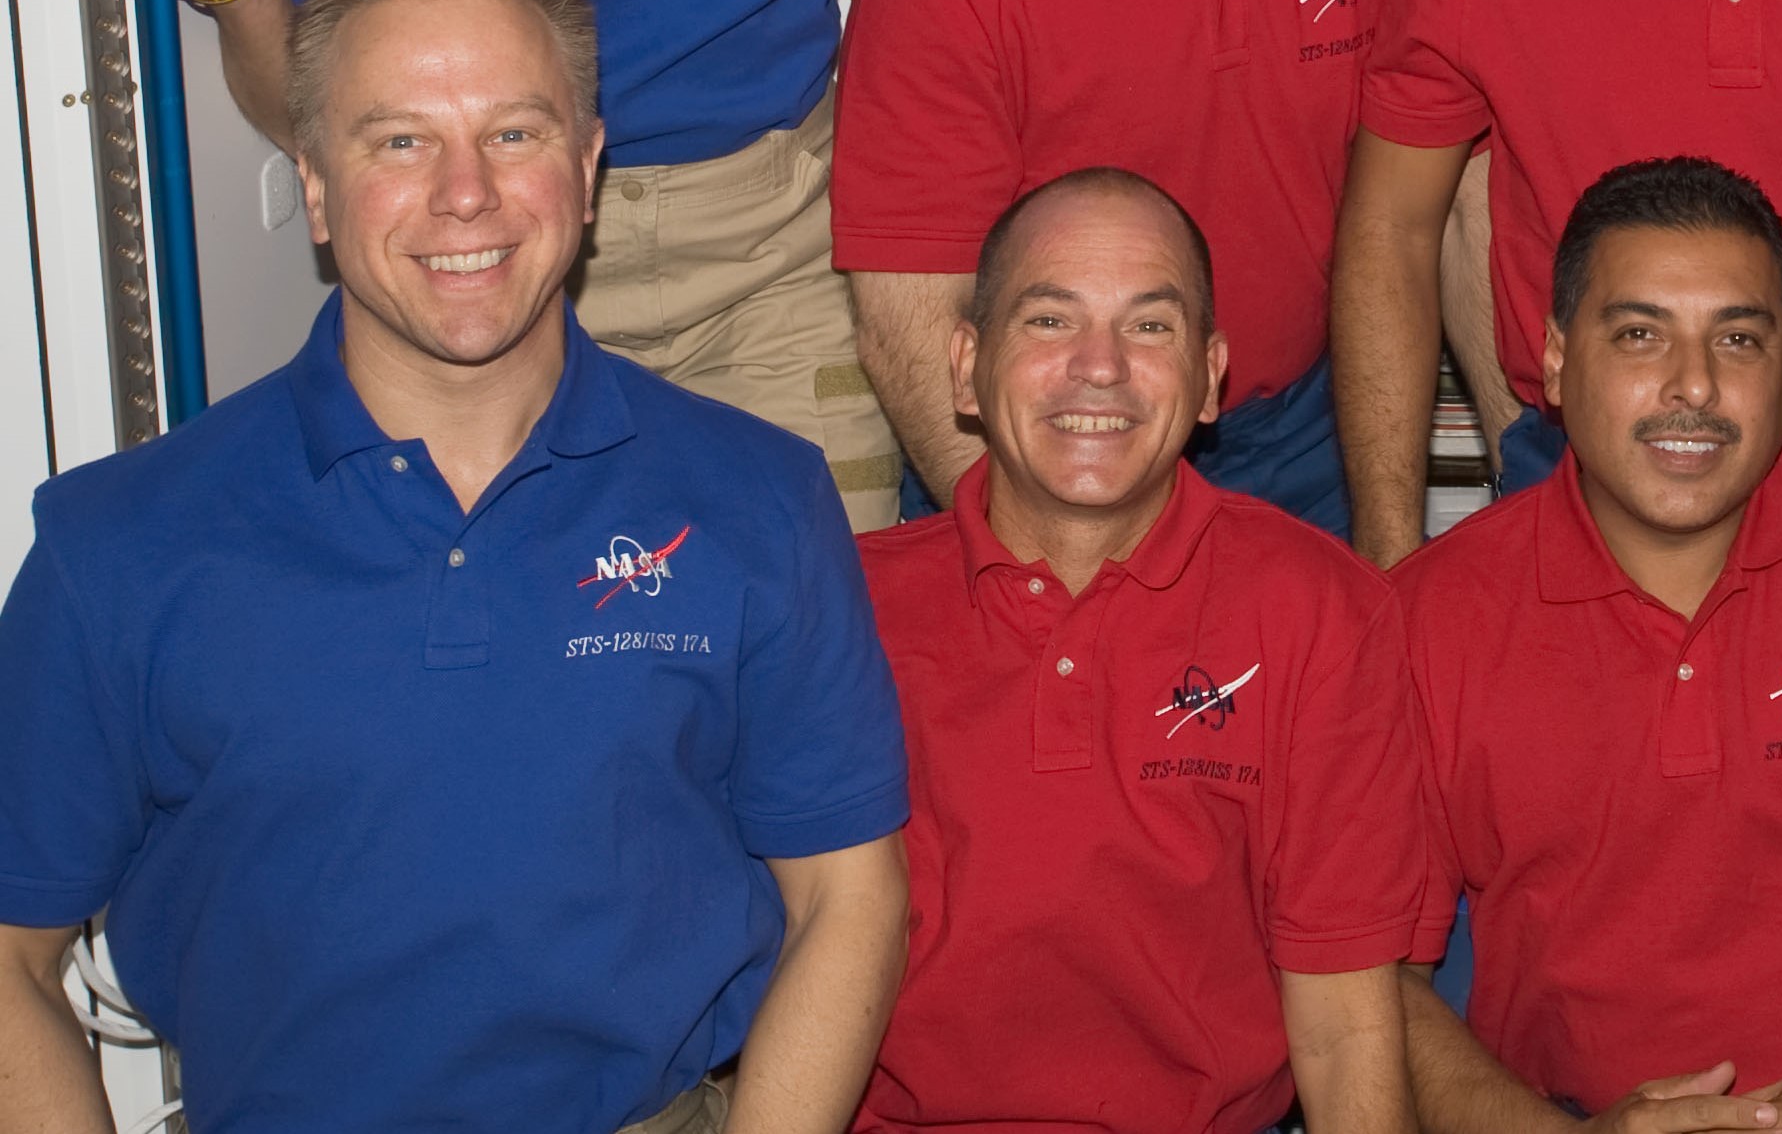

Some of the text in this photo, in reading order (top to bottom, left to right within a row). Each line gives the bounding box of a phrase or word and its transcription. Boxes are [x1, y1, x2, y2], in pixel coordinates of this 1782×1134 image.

[595, 552, 673, 580] NASA
[566, 631, 712, 658] STS-128/ISS 17A
[1172, 685, 1236, 714] NASA
[1236, 765, 1261, 786] 17A
